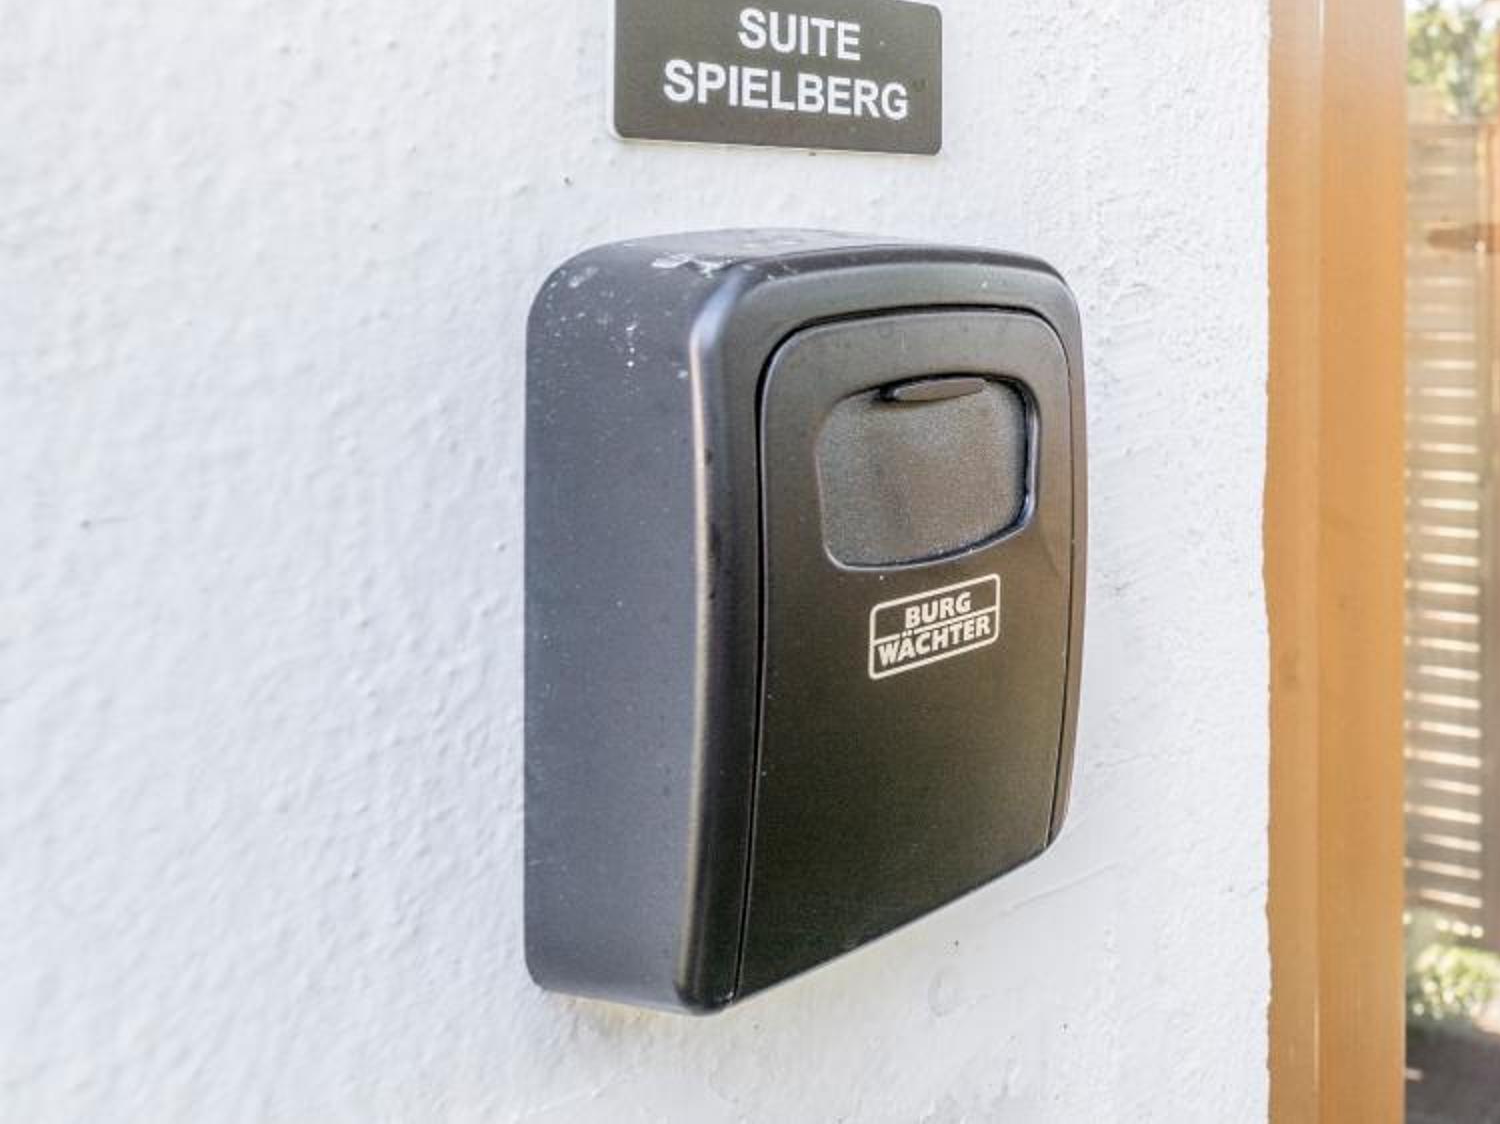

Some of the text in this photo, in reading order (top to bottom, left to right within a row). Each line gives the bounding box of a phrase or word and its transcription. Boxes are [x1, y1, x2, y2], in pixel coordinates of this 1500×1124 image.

[737, 7, 861, 61] SUITE
[663, 58, 909, 121] SPIELBERG
[905, 591, 972, 629] BURG
[877, 615, 992, 667] WÄCHTER
